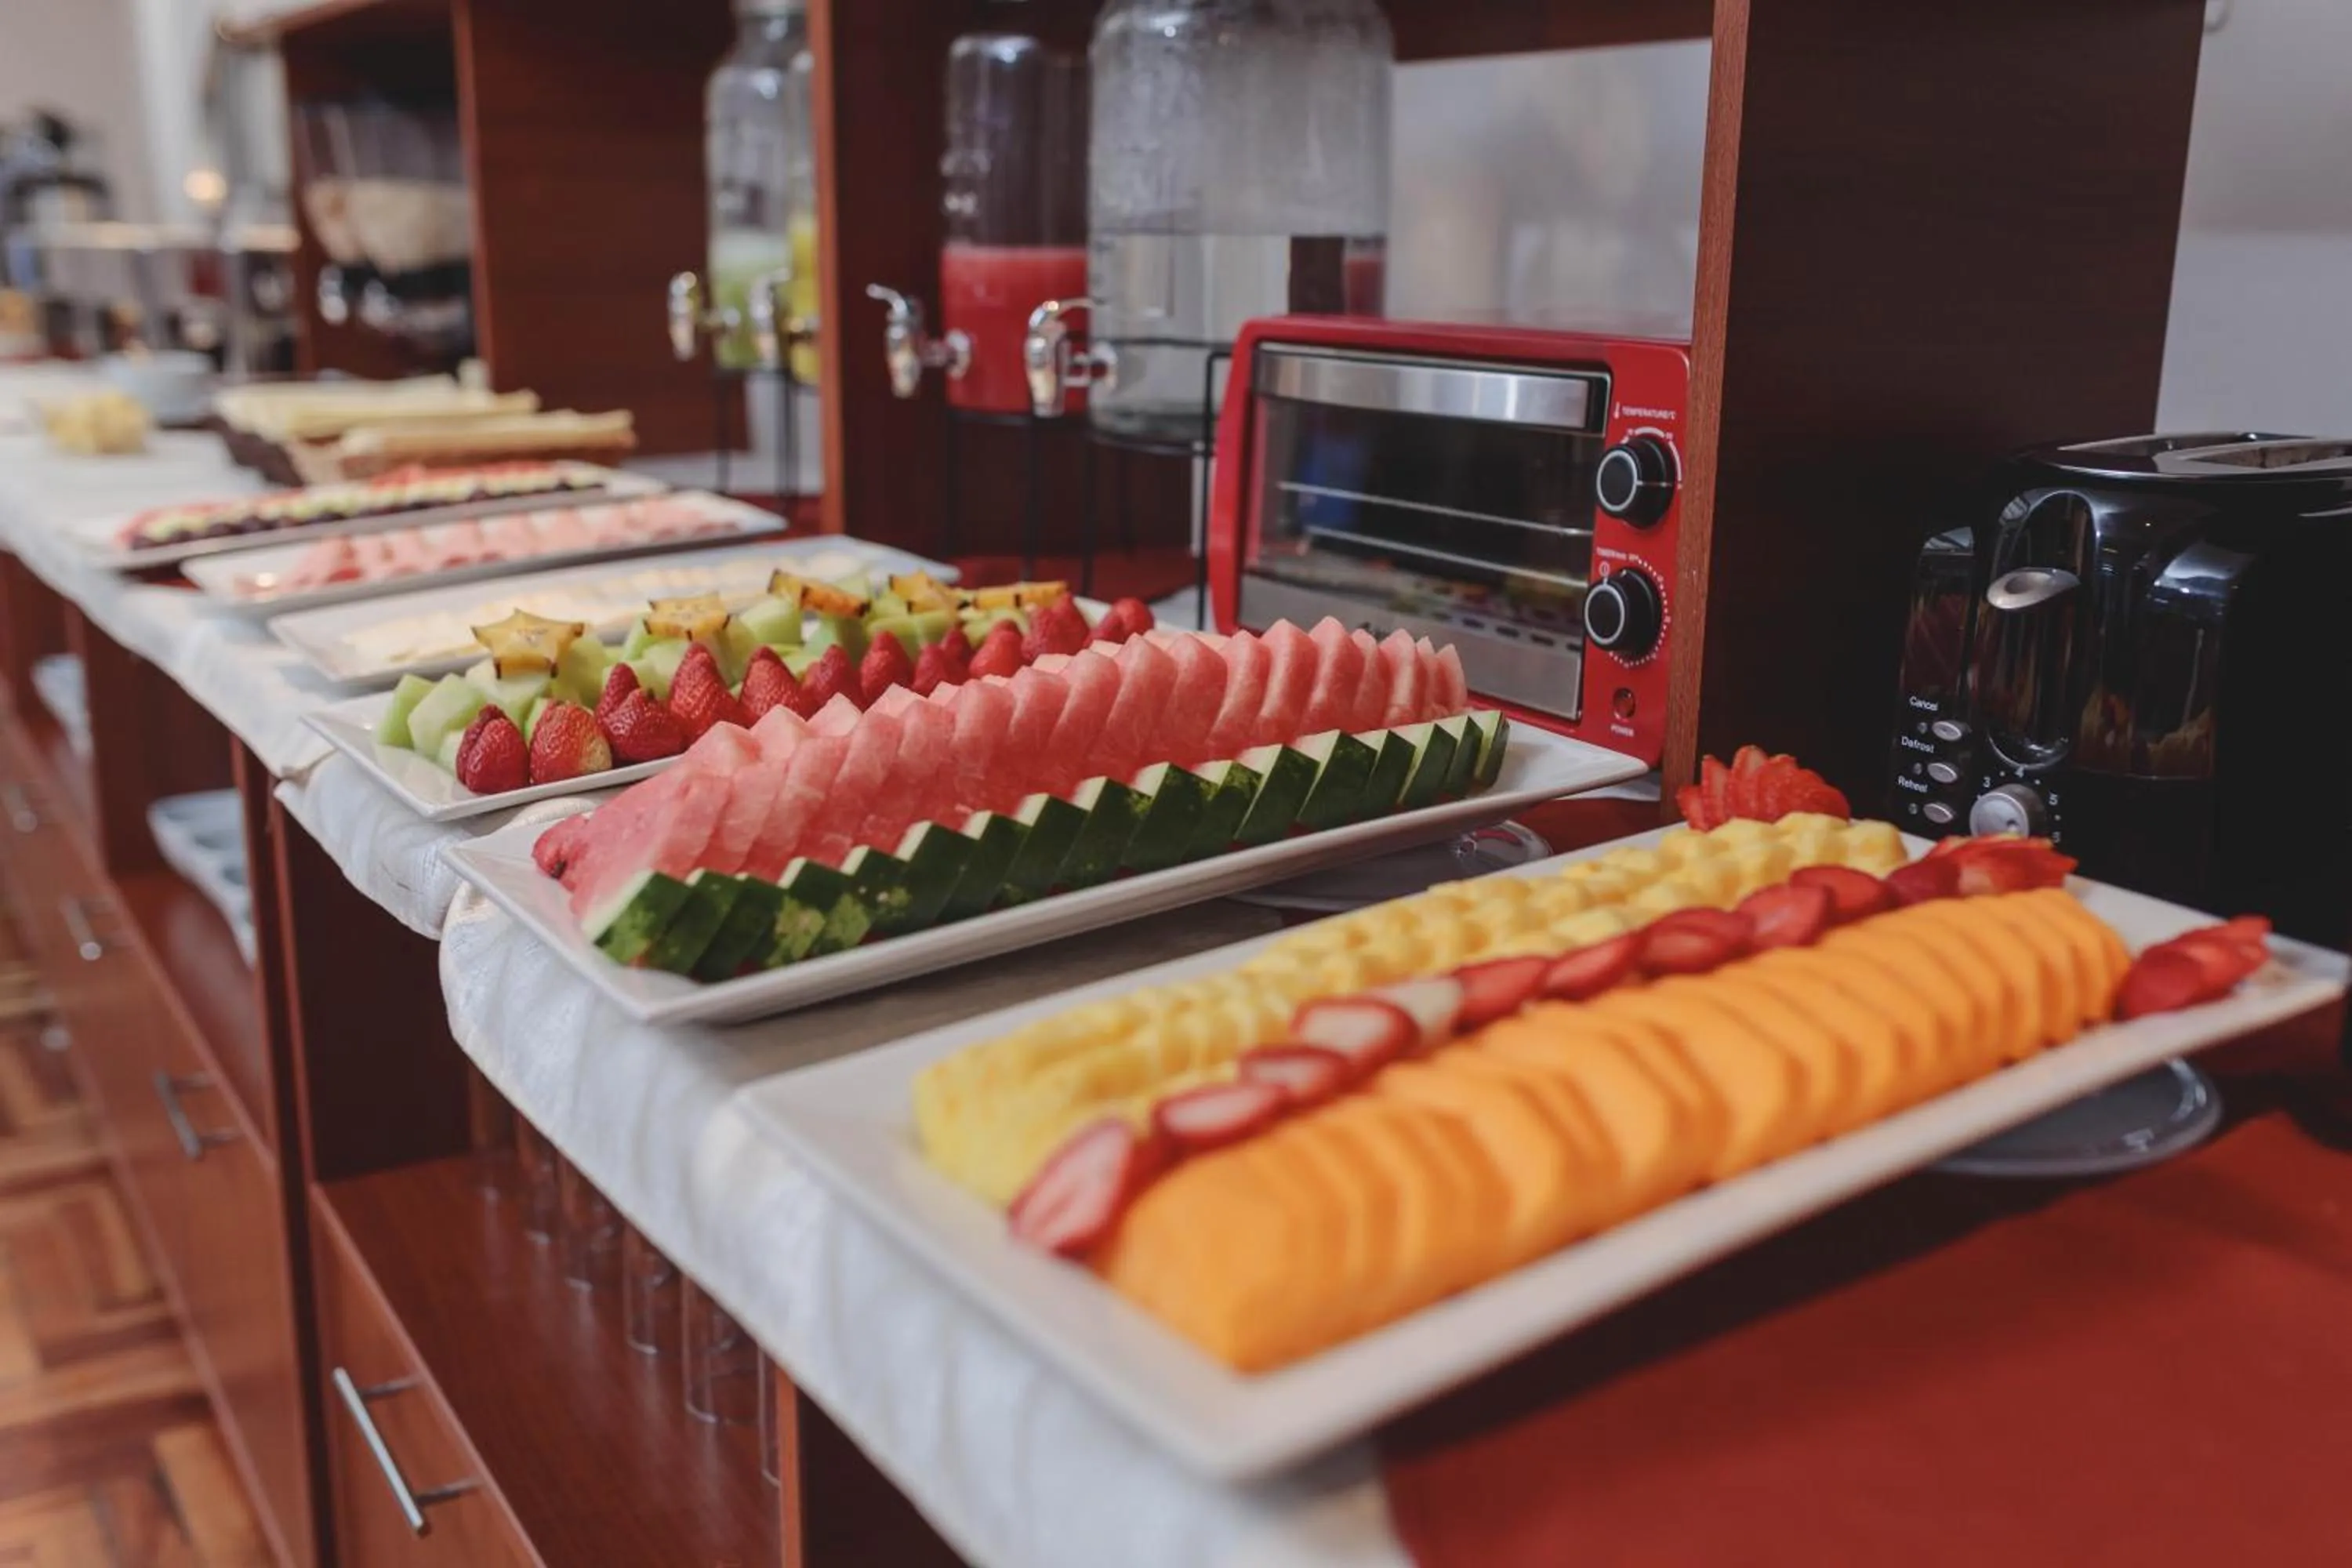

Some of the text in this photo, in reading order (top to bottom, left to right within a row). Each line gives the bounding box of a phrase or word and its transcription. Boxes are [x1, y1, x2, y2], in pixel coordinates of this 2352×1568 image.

[1909, 696, 1938, 711] Cancel
[1901, 736, 1934, 753] Defrost
[1898, 775, 1928, 793] Reheat
[1983, 776, 1991, 788] 3
[2049, 793, 2058, 805] 5
